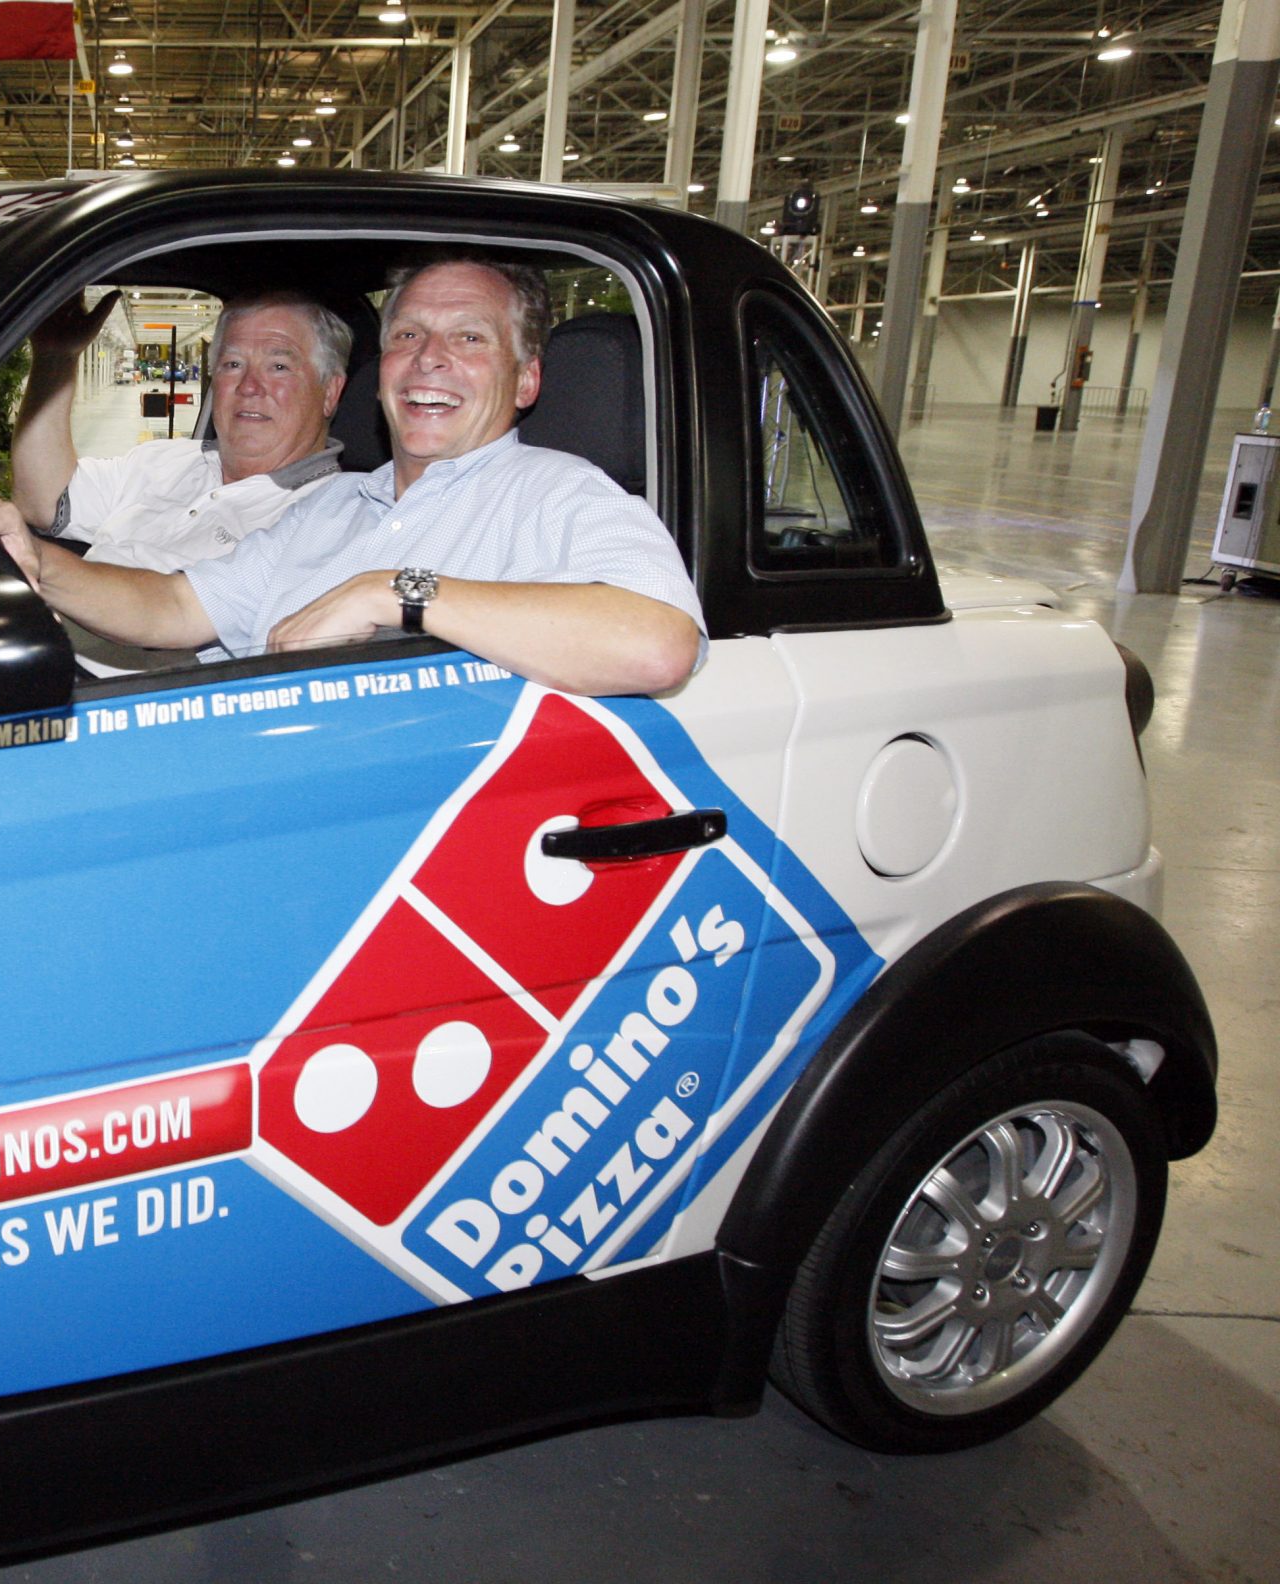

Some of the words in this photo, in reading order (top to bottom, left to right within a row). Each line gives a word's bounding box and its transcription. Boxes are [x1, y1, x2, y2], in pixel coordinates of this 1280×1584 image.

[87, 707, 128, 735] The
[135, 696, 204, 727] World
[212, 686, 302, 717] Greener
[309, 680, 349, 703] One
[355, 672, 412, 697] Pizza
[418, 666, 441, 690] At
[445, 664, 460, 686] A
[426, 904, 745, 1269] Domino's
[45, 1196, 119, 1256] WE
[137, 1176, 229, 1236] DID.
[485, 1096, 694, 1292] Pizza
